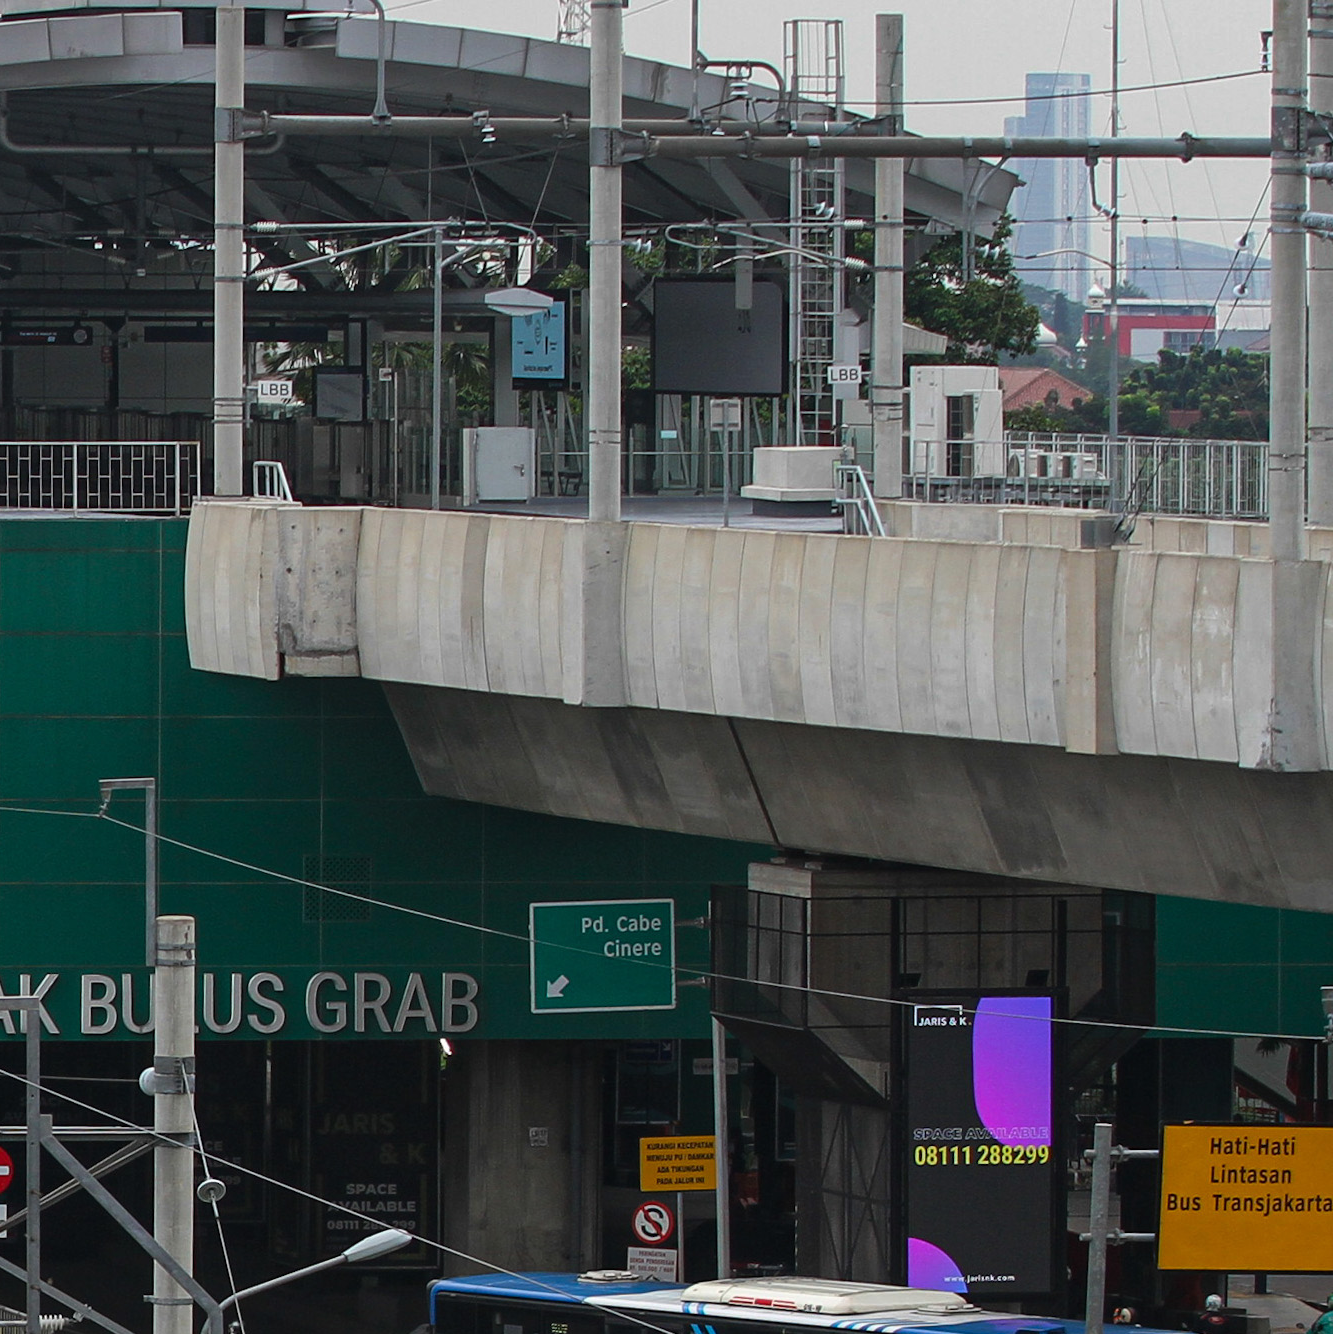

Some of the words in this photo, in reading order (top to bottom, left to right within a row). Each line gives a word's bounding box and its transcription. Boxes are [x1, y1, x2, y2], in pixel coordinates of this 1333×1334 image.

[830, 368, 859, 382] LBB
[260, 383, 289, 396] LBB
[581, 915, 609, 933] Pd.
[616, 914, 662, 932] Cabe
[603, 939, 662, 957] Cinere
[80, 972, 286, 1035] BUUS
[306, 972, 480, 1034] GRAB
[918, 1016, 947, 1026] JARIS
[949, 1016, 957, 1026] &
[913, 1128, 963, 1140] SPACE
[965, 1127, 1049, 1140] AVAILABLE
[646, 1142, 676, 1150] KURANGI
[1210, 1136, 1296, 1155] Hati-Hati
[914, 1145, 971, 1165] 08111
[977, 1145, 1049, 1165] 288299
[1210, 1164, 1292, 1184] Lintasan
[346, 1183, 397, 1195] SPACE
[327, 1201, 416, 1212] AVAILABLE
[1167, 1193, 1201, 1211] Bus
[1212, 1193, 1333, 1217] Transjakarta
[327, 1220, 359, 1230] 08111
